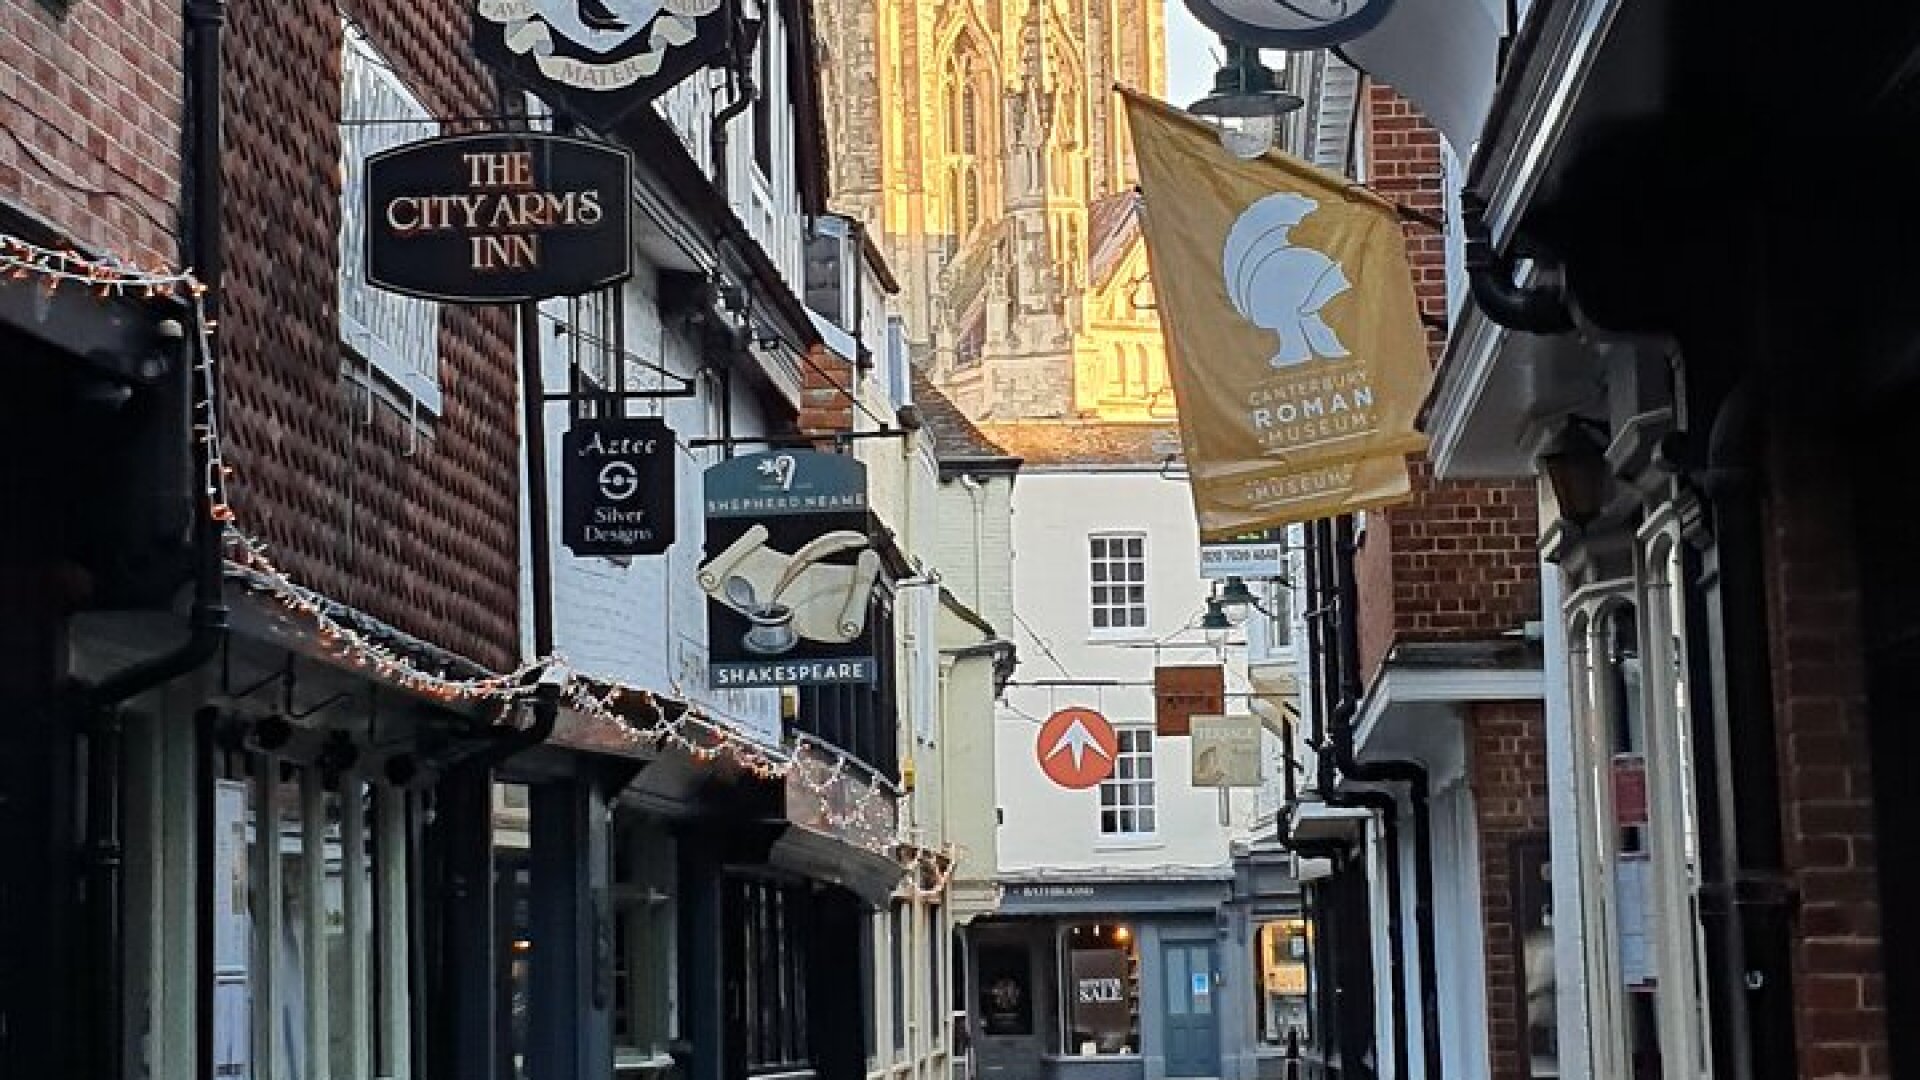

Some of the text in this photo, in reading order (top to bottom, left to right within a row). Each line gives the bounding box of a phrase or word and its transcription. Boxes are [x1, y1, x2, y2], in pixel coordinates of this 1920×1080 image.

[562, 61, 643, 85] MATER
[463, 152, 533, 186] THE
[386, 190, 602, 231] CITY ARMS
[470, 235, 540, 269] INN
[1249, 369, 1368, 405] CANTERBURY
[1255, 386, 1374, 428] ROMAN
[578, 430, 658, 457] Aztec
[594, 506, 646, 524] Silver
[708, 492, 866, 513] SHEPHERD NEAME
[583, 525, 654, 545] Designs
[718, 661, 864, 684] SHAKESPEARE
